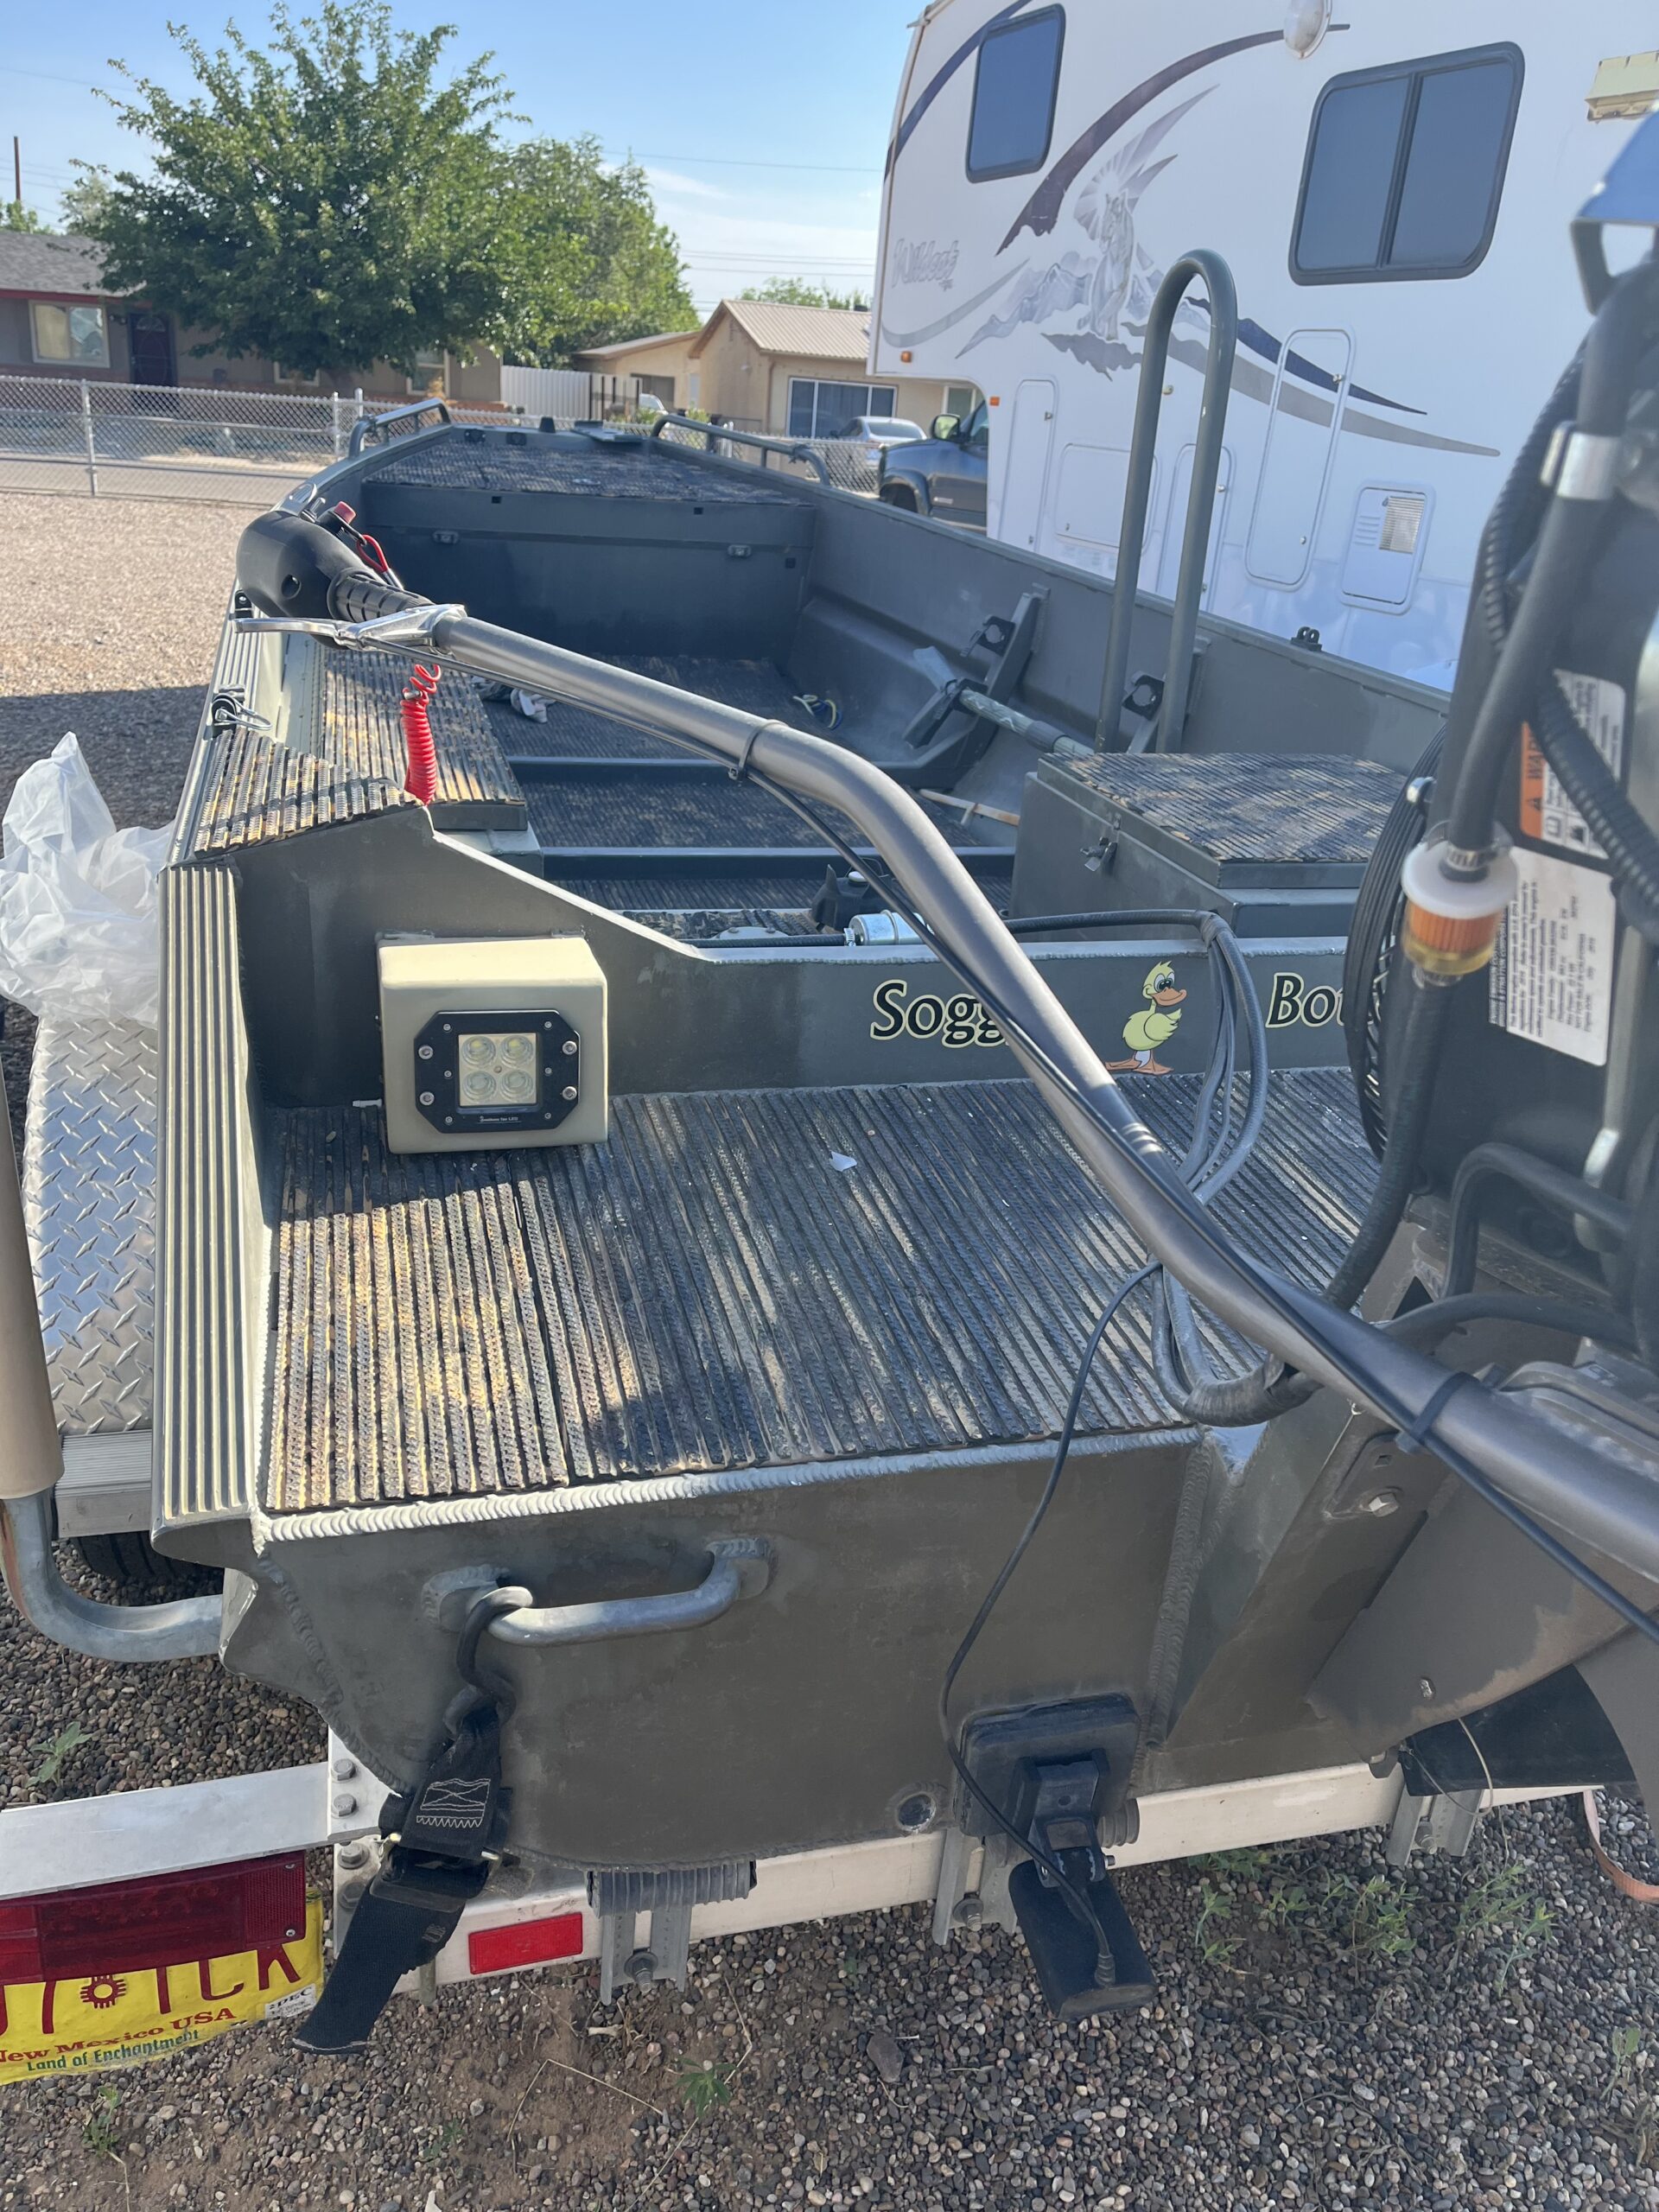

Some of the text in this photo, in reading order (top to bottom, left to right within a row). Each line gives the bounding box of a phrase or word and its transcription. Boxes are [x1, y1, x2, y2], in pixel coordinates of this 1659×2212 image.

[870, 979, 1007, 1048] Sogg
[0, 2007, 236, 2063] ew Mexico USA
[28, 2030, 199, 2072] Land of Enchantment
